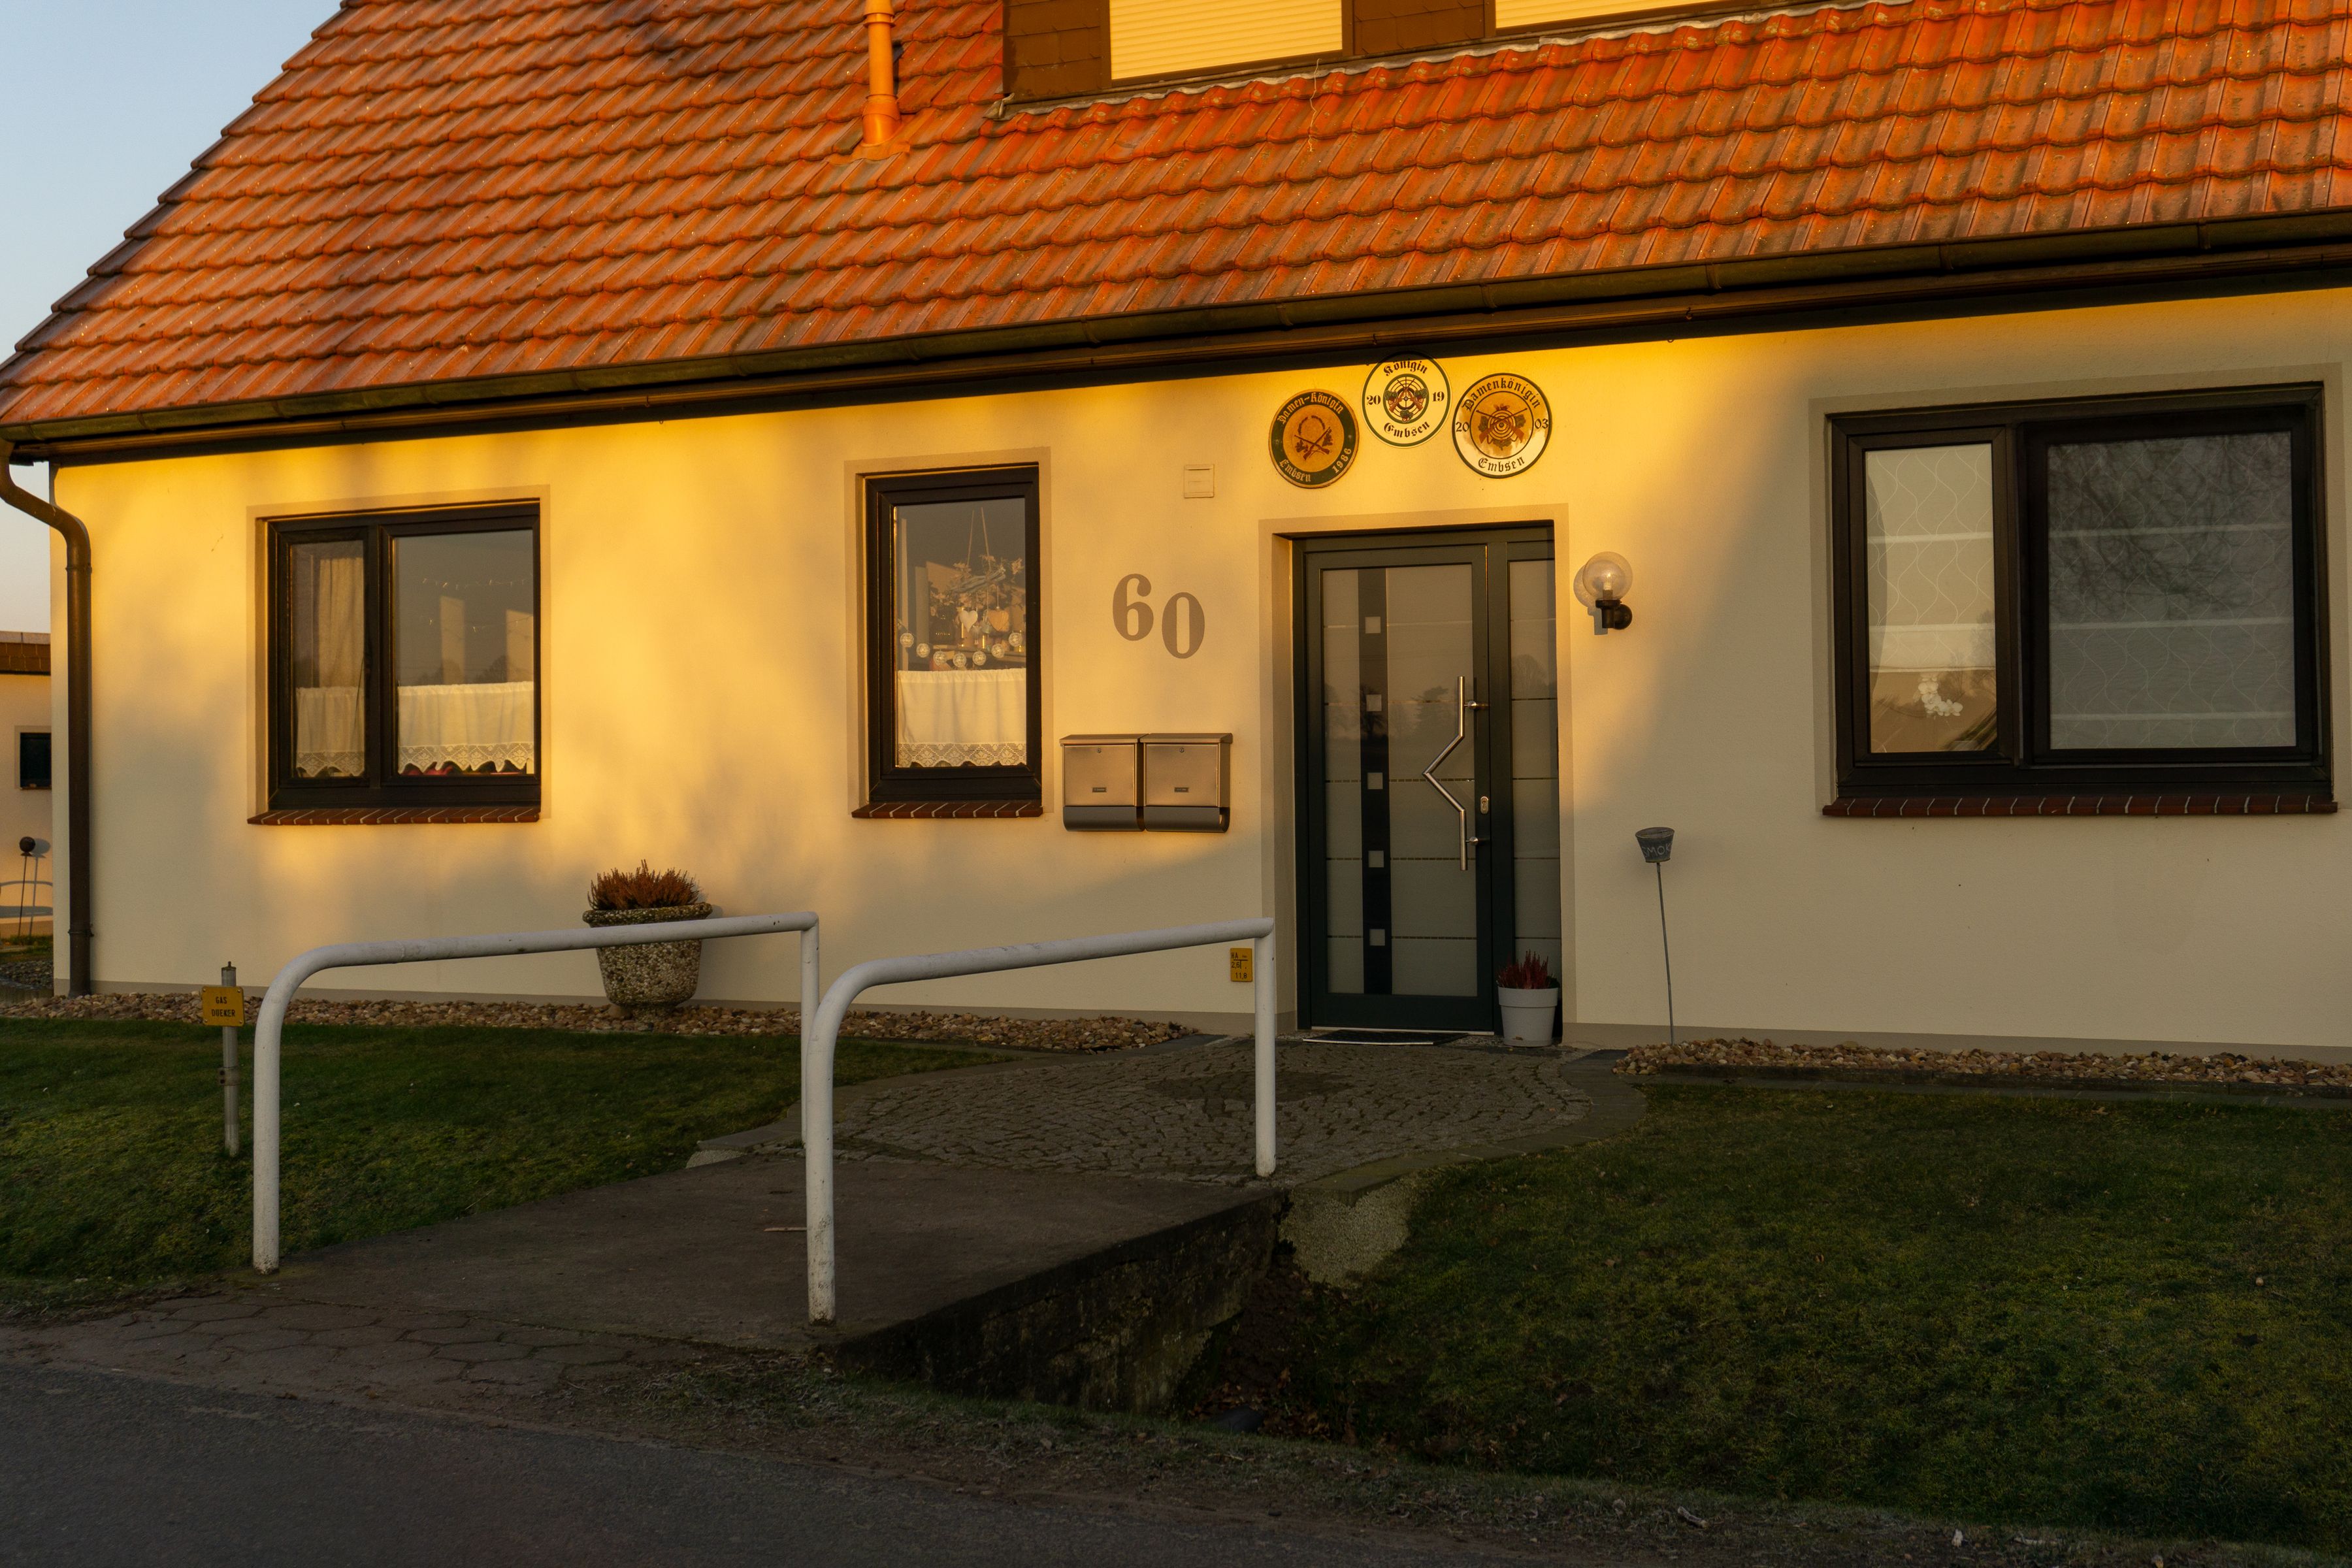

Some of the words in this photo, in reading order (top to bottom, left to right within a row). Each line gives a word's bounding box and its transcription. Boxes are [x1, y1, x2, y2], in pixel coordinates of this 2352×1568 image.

[1366, 395, 1381, 405] 20
[1432, 391, 1445, 402] 19
[1462, 378, 1541, 412] Damenkönigin
[1384, 421, 1429, 438] Embsen
[1456, 421, 1469, 432] 20
[1535, 418, 1548, 429] 03
[1280, 459, 1311, 482] Embsen
[1332, 448, 1352, 474] 1986
[1478, 457, 1525, 472] Embsen
[1112, 573, 1205, 659] 60
